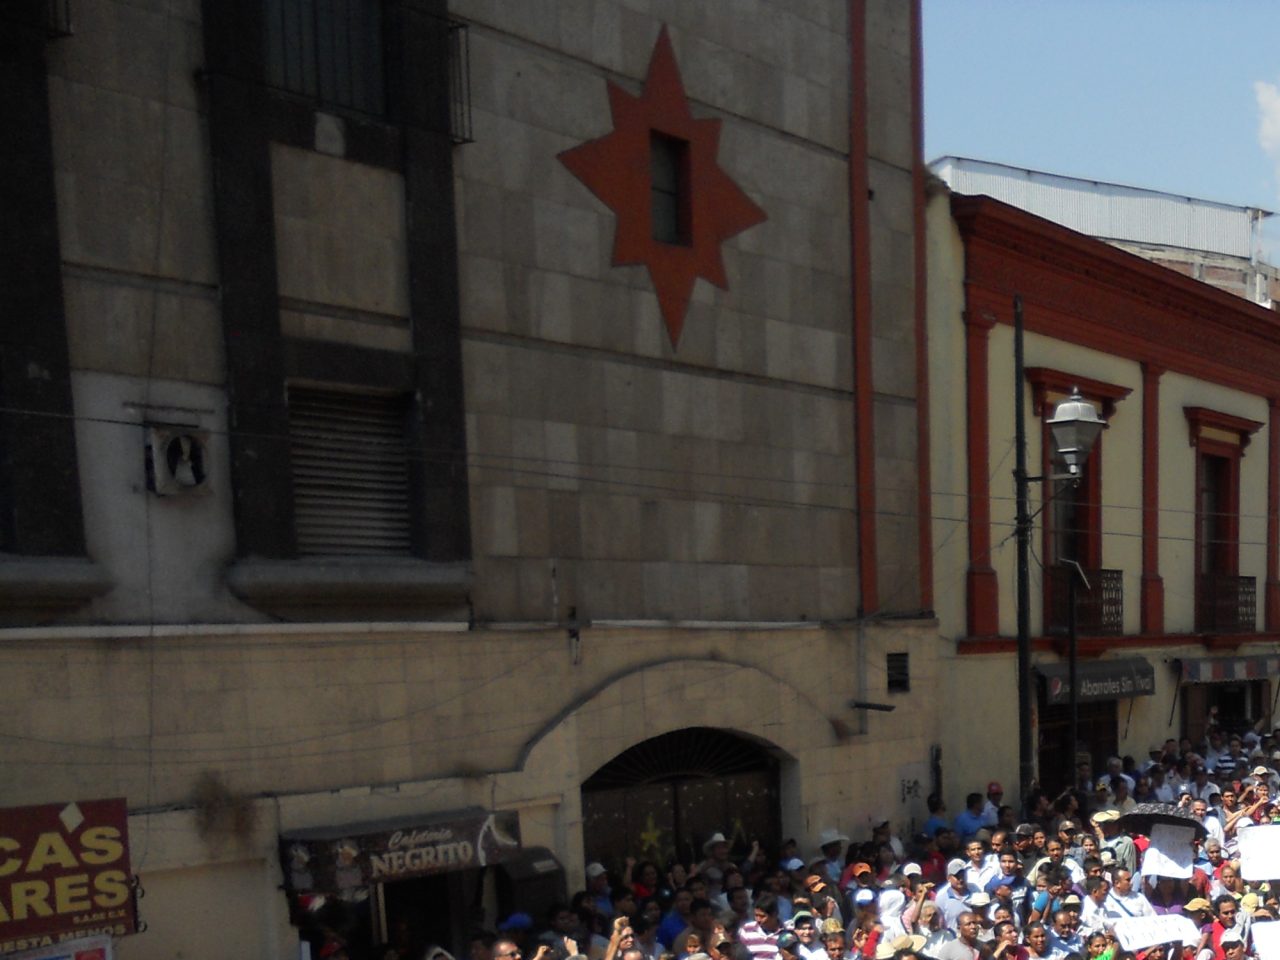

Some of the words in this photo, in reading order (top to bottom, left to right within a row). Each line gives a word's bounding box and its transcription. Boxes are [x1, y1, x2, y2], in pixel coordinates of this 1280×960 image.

[1080, 678, 1120, 697] Abarrotes
[370, 841, 476, 878] NEGRITO
[0, 935, 53, 953] ESTA
